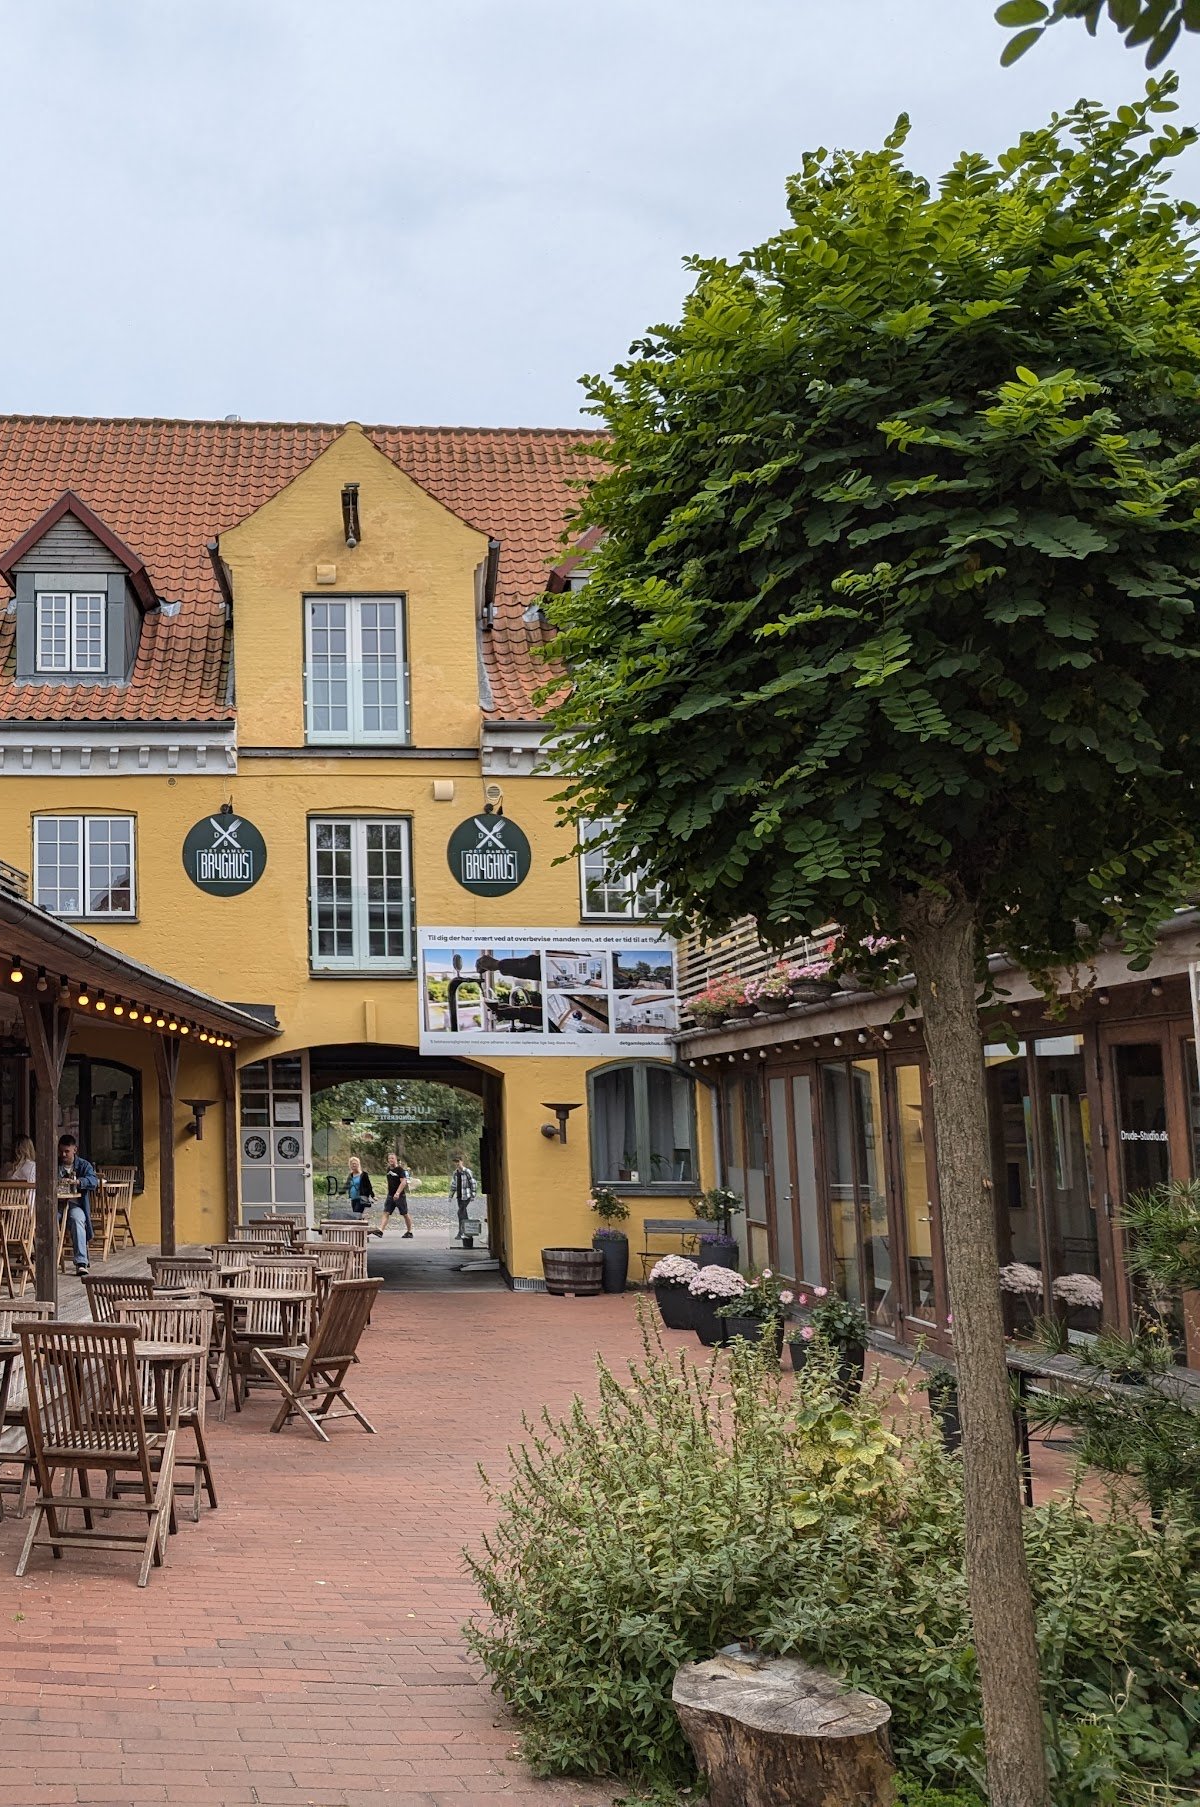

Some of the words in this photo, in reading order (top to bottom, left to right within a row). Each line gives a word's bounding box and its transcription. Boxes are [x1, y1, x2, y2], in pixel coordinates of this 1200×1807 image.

[201, 853, 249, 879] BRYGHUS
[465, 853, 514, 880] BRYGHUS
[1120, 1130, 1168, 1141] Drude-Studio.dk
